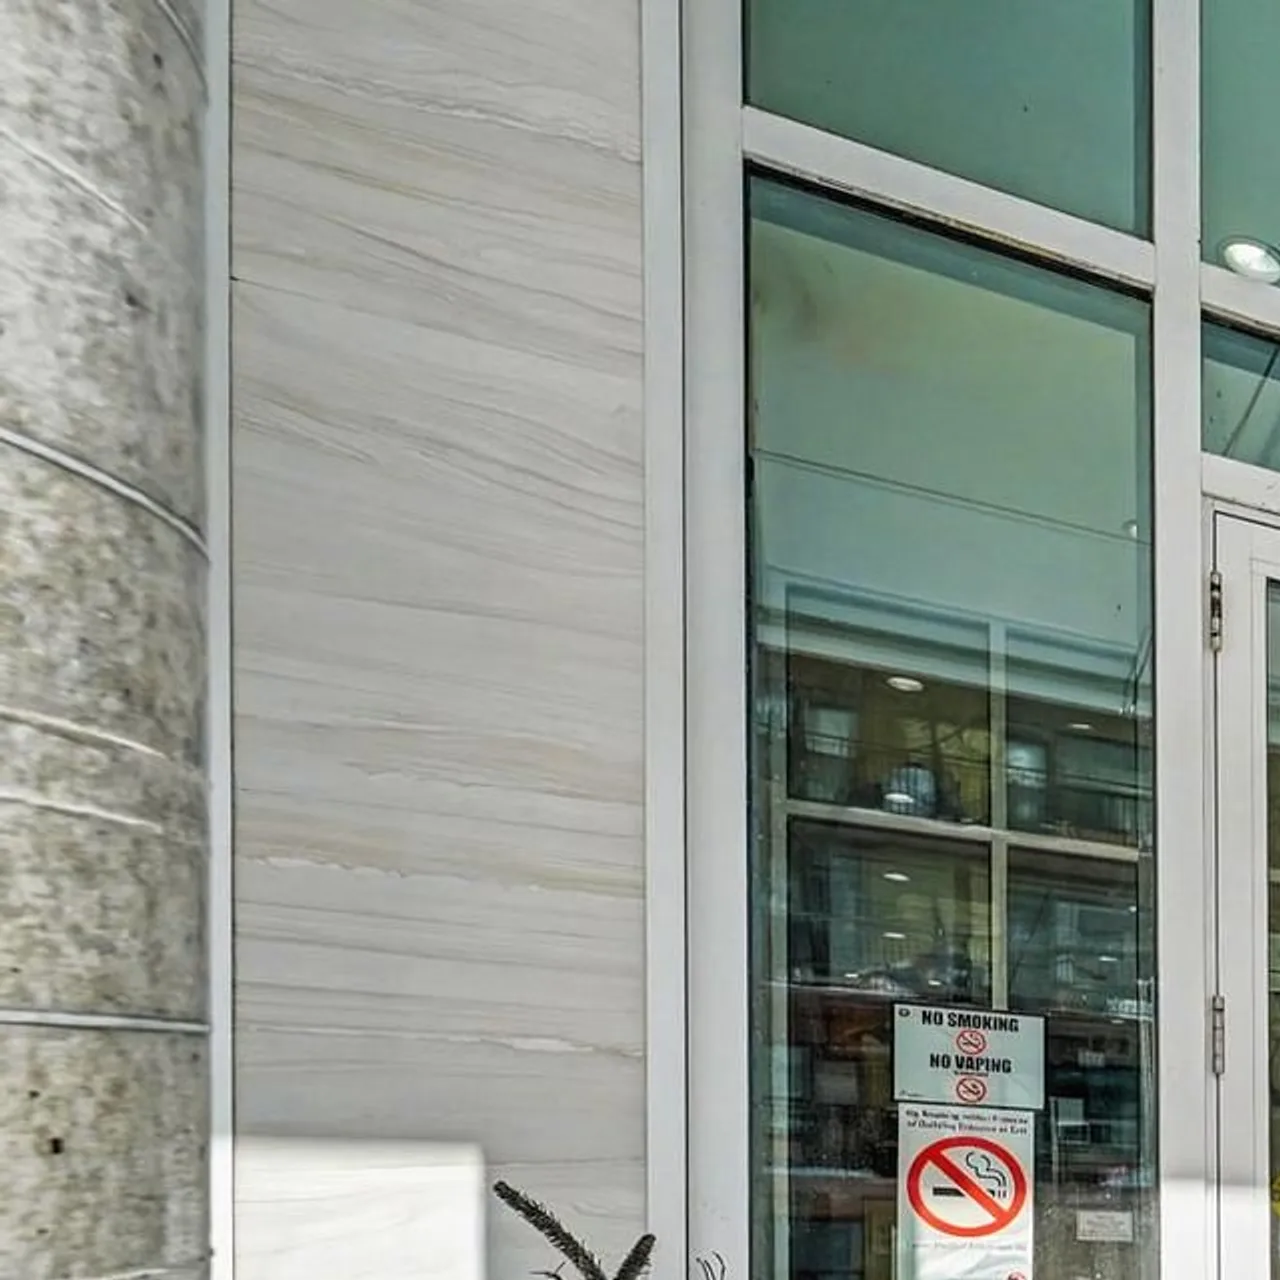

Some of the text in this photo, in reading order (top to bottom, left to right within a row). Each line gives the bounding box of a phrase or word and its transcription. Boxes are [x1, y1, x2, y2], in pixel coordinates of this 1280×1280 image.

[921, 1010, 1020, 1032] NO SMOKING
[929, 1053, 1012, 1073] NO VAPING
